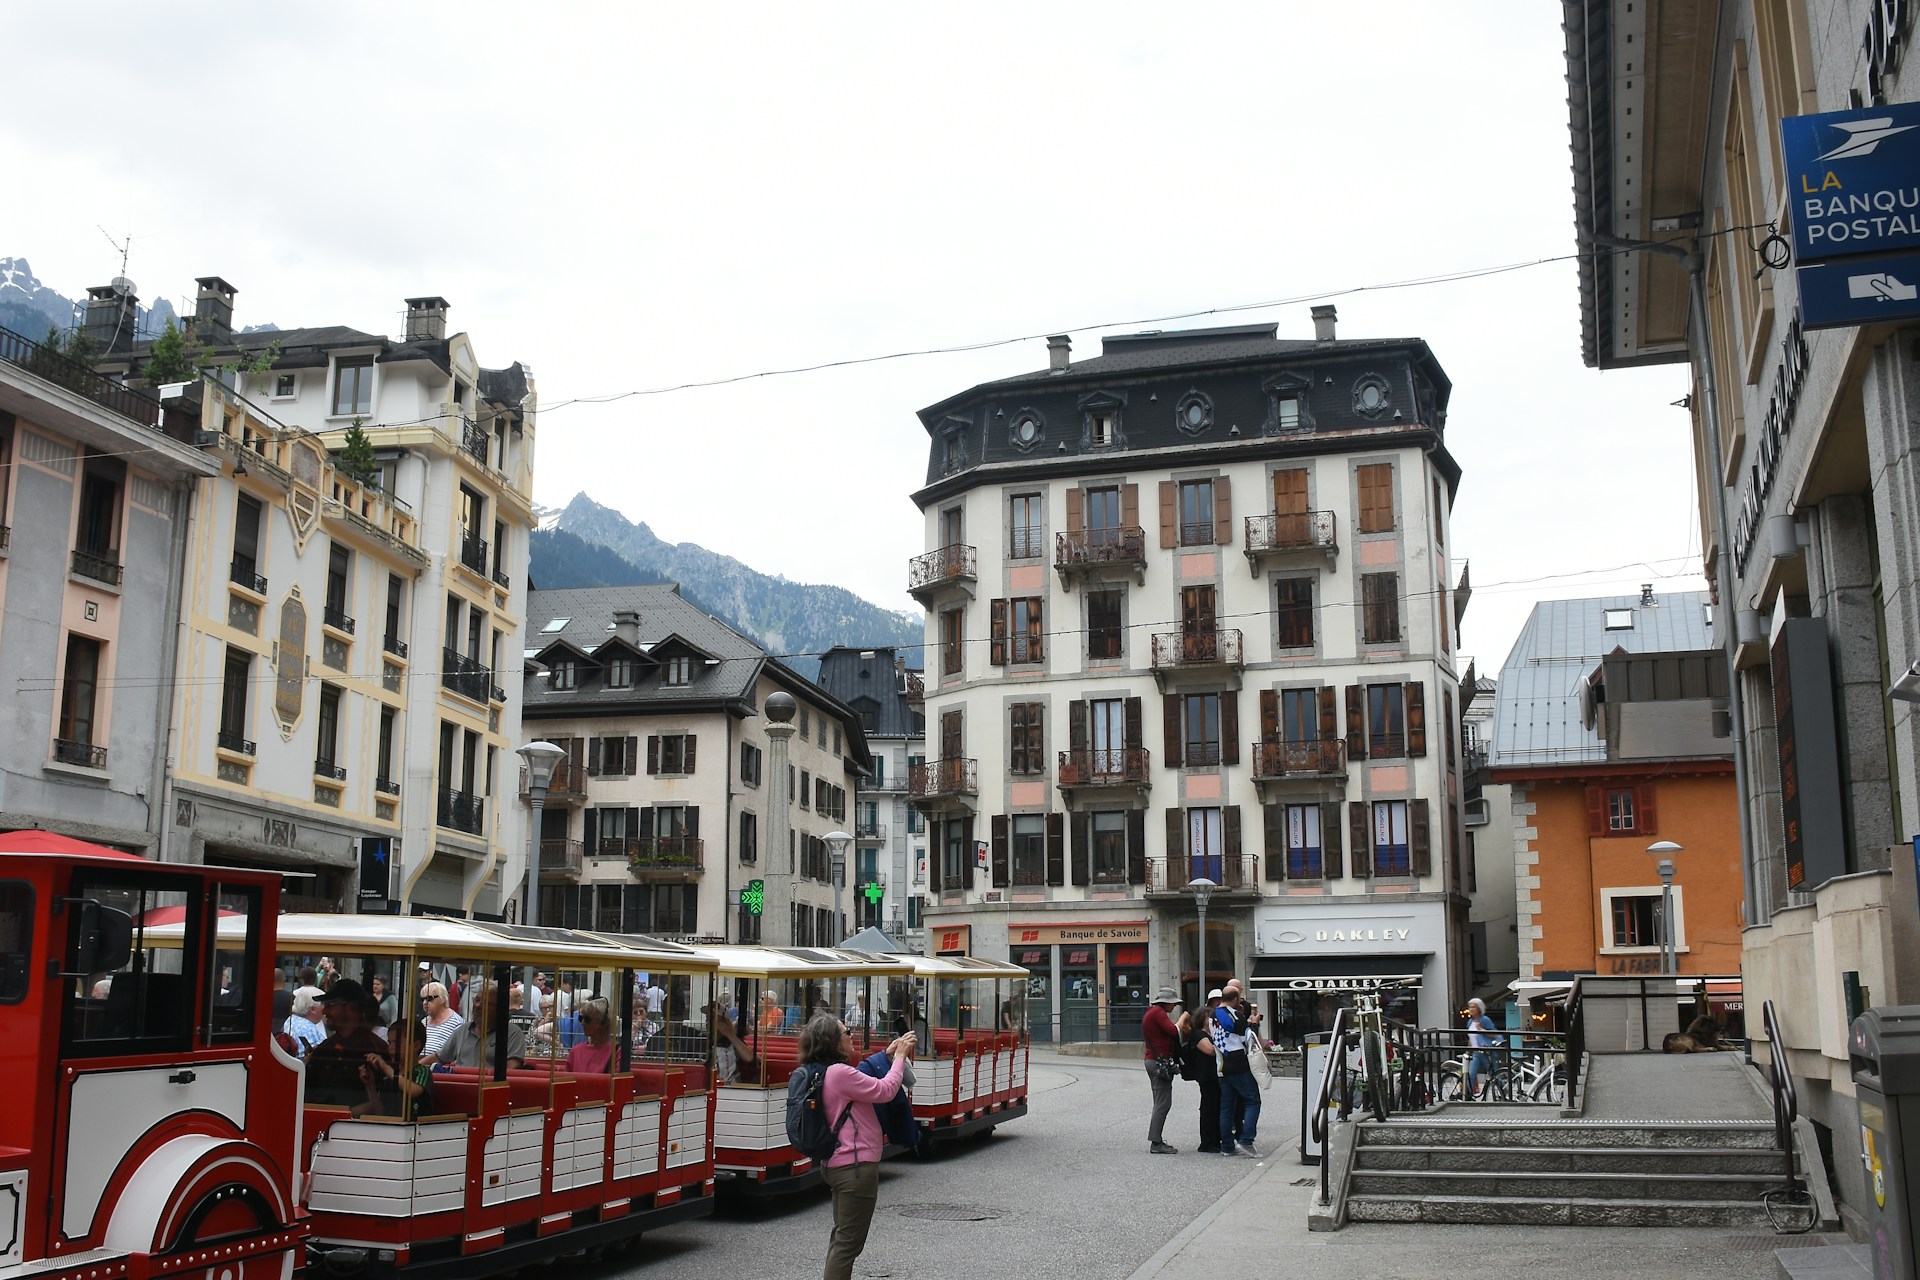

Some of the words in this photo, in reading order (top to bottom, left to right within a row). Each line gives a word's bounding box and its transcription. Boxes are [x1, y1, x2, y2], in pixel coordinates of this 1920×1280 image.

[1801, 171, 1843, 193] LA
[1804, 187, 1920, 219] BANQU
[1807, 214, 1920, 245] POSTAL
[1060, 930, 1093, 940] Banque
[1097, 929, 1108, 938] de
[1111, 928, 1142, 938] Savoie
[1315, 928, 1410, 941] OAKLEY
[1612, 959, 1626, 974] LA
[1314, 978, 1383, 988] OAKLEY
